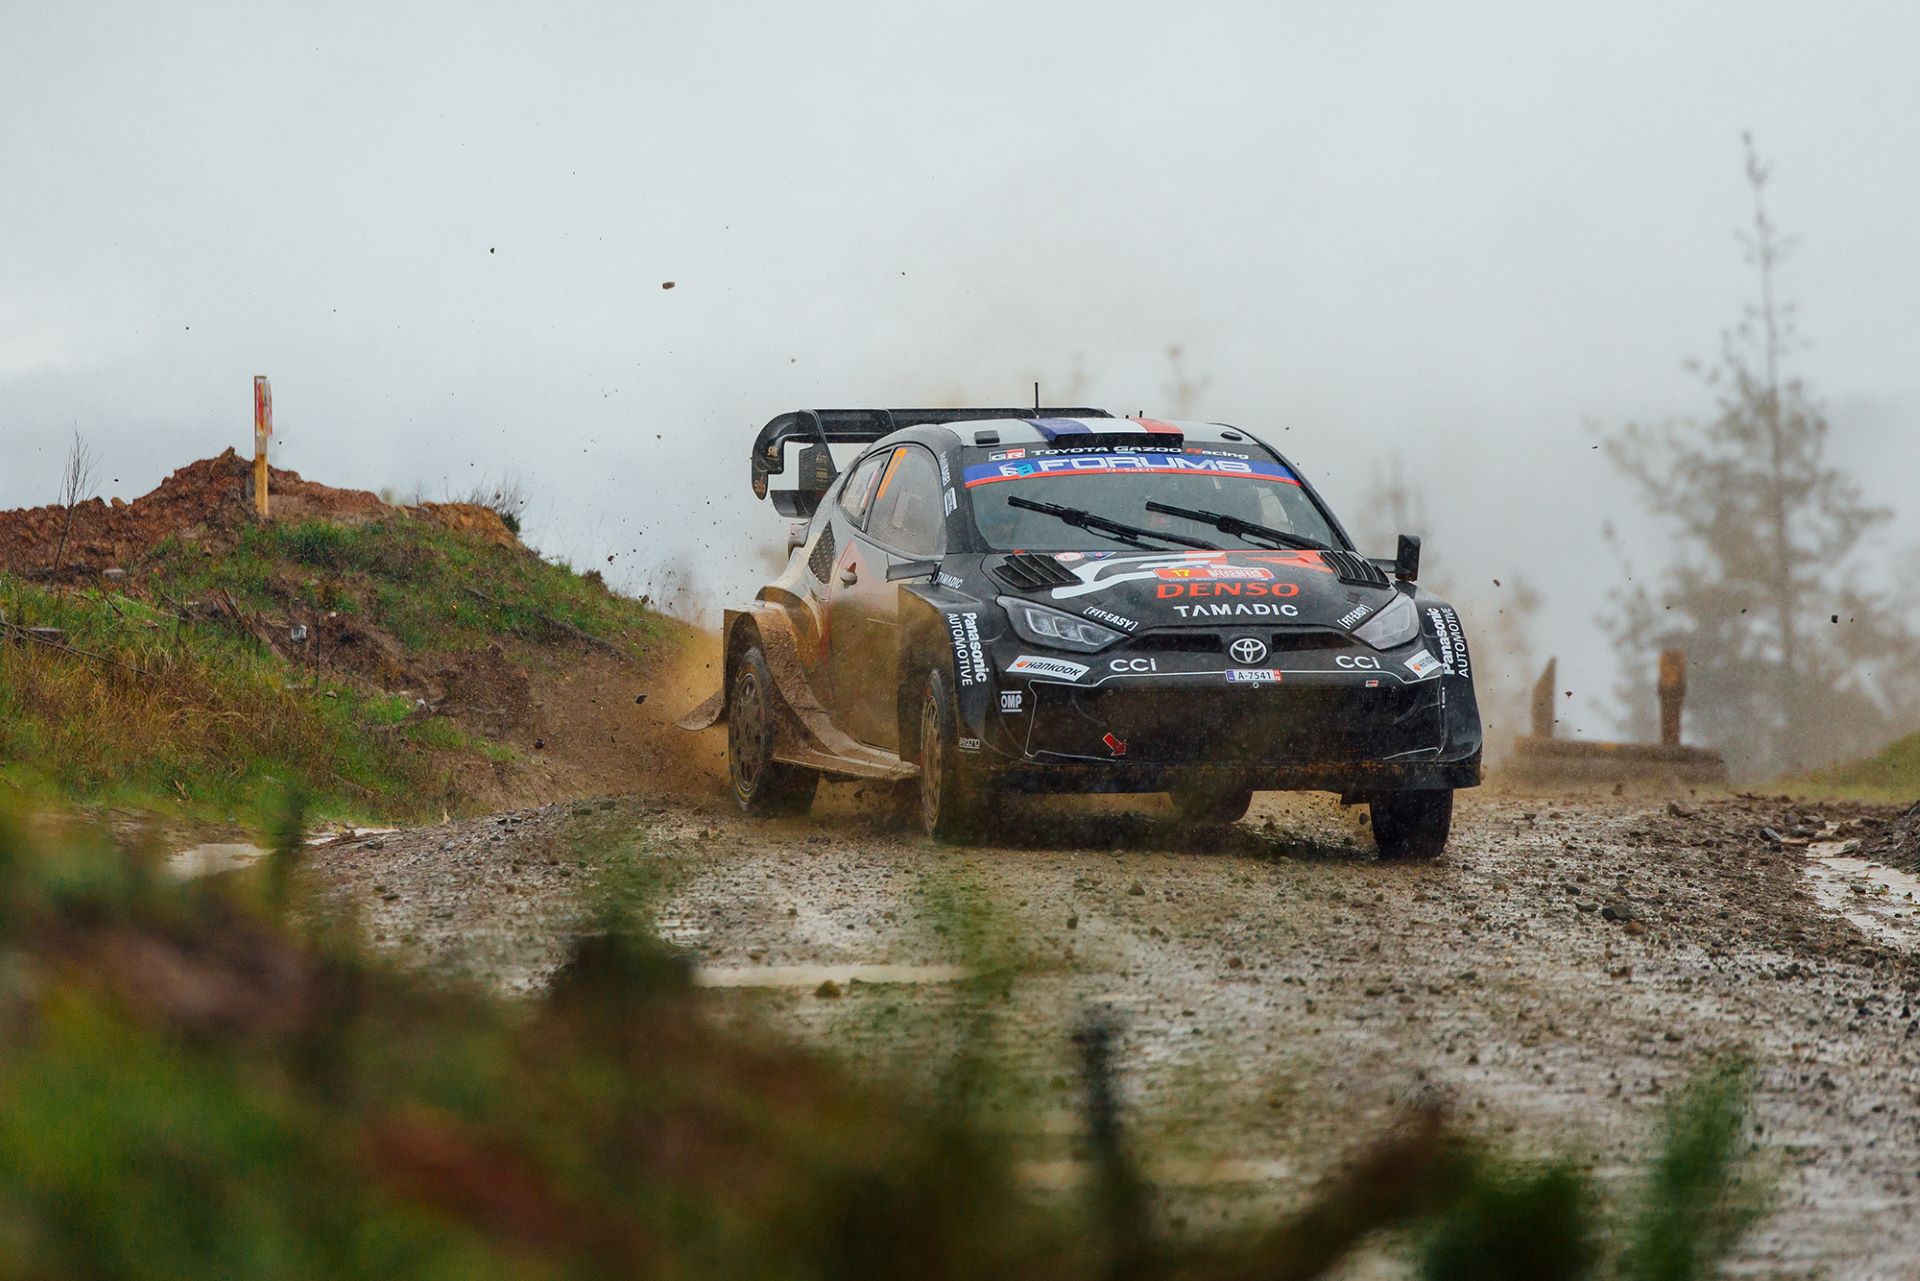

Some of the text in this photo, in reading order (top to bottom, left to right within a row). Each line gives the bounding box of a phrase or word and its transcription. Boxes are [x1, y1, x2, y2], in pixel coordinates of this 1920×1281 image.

[1031, 446, 1109, 456] TOYOTA
[1115, 446, 1182, 454] GAZOO
[1186, 447, 1249, 460] Racing
[877, 447, 907, 499] 17
[1038, 456, 1252, 473] FORUM8
[1169, 568, 1191, 578] 17
[1156, 582, 1300, 599] DENSO
[1173, 603, 1299, 618] TAMADIC
[947, 612, 973, 687] AUTOMOTIVE
[962, 612, 989, 684] Panasonic
[1426, 606, 1456, 676] Panasonic
[1440, 606, 1470, 679] AUTOMOTIVE
[1238, 671, 1272, 680] A-7541
[1000, 694, 1023, 709] OMP
